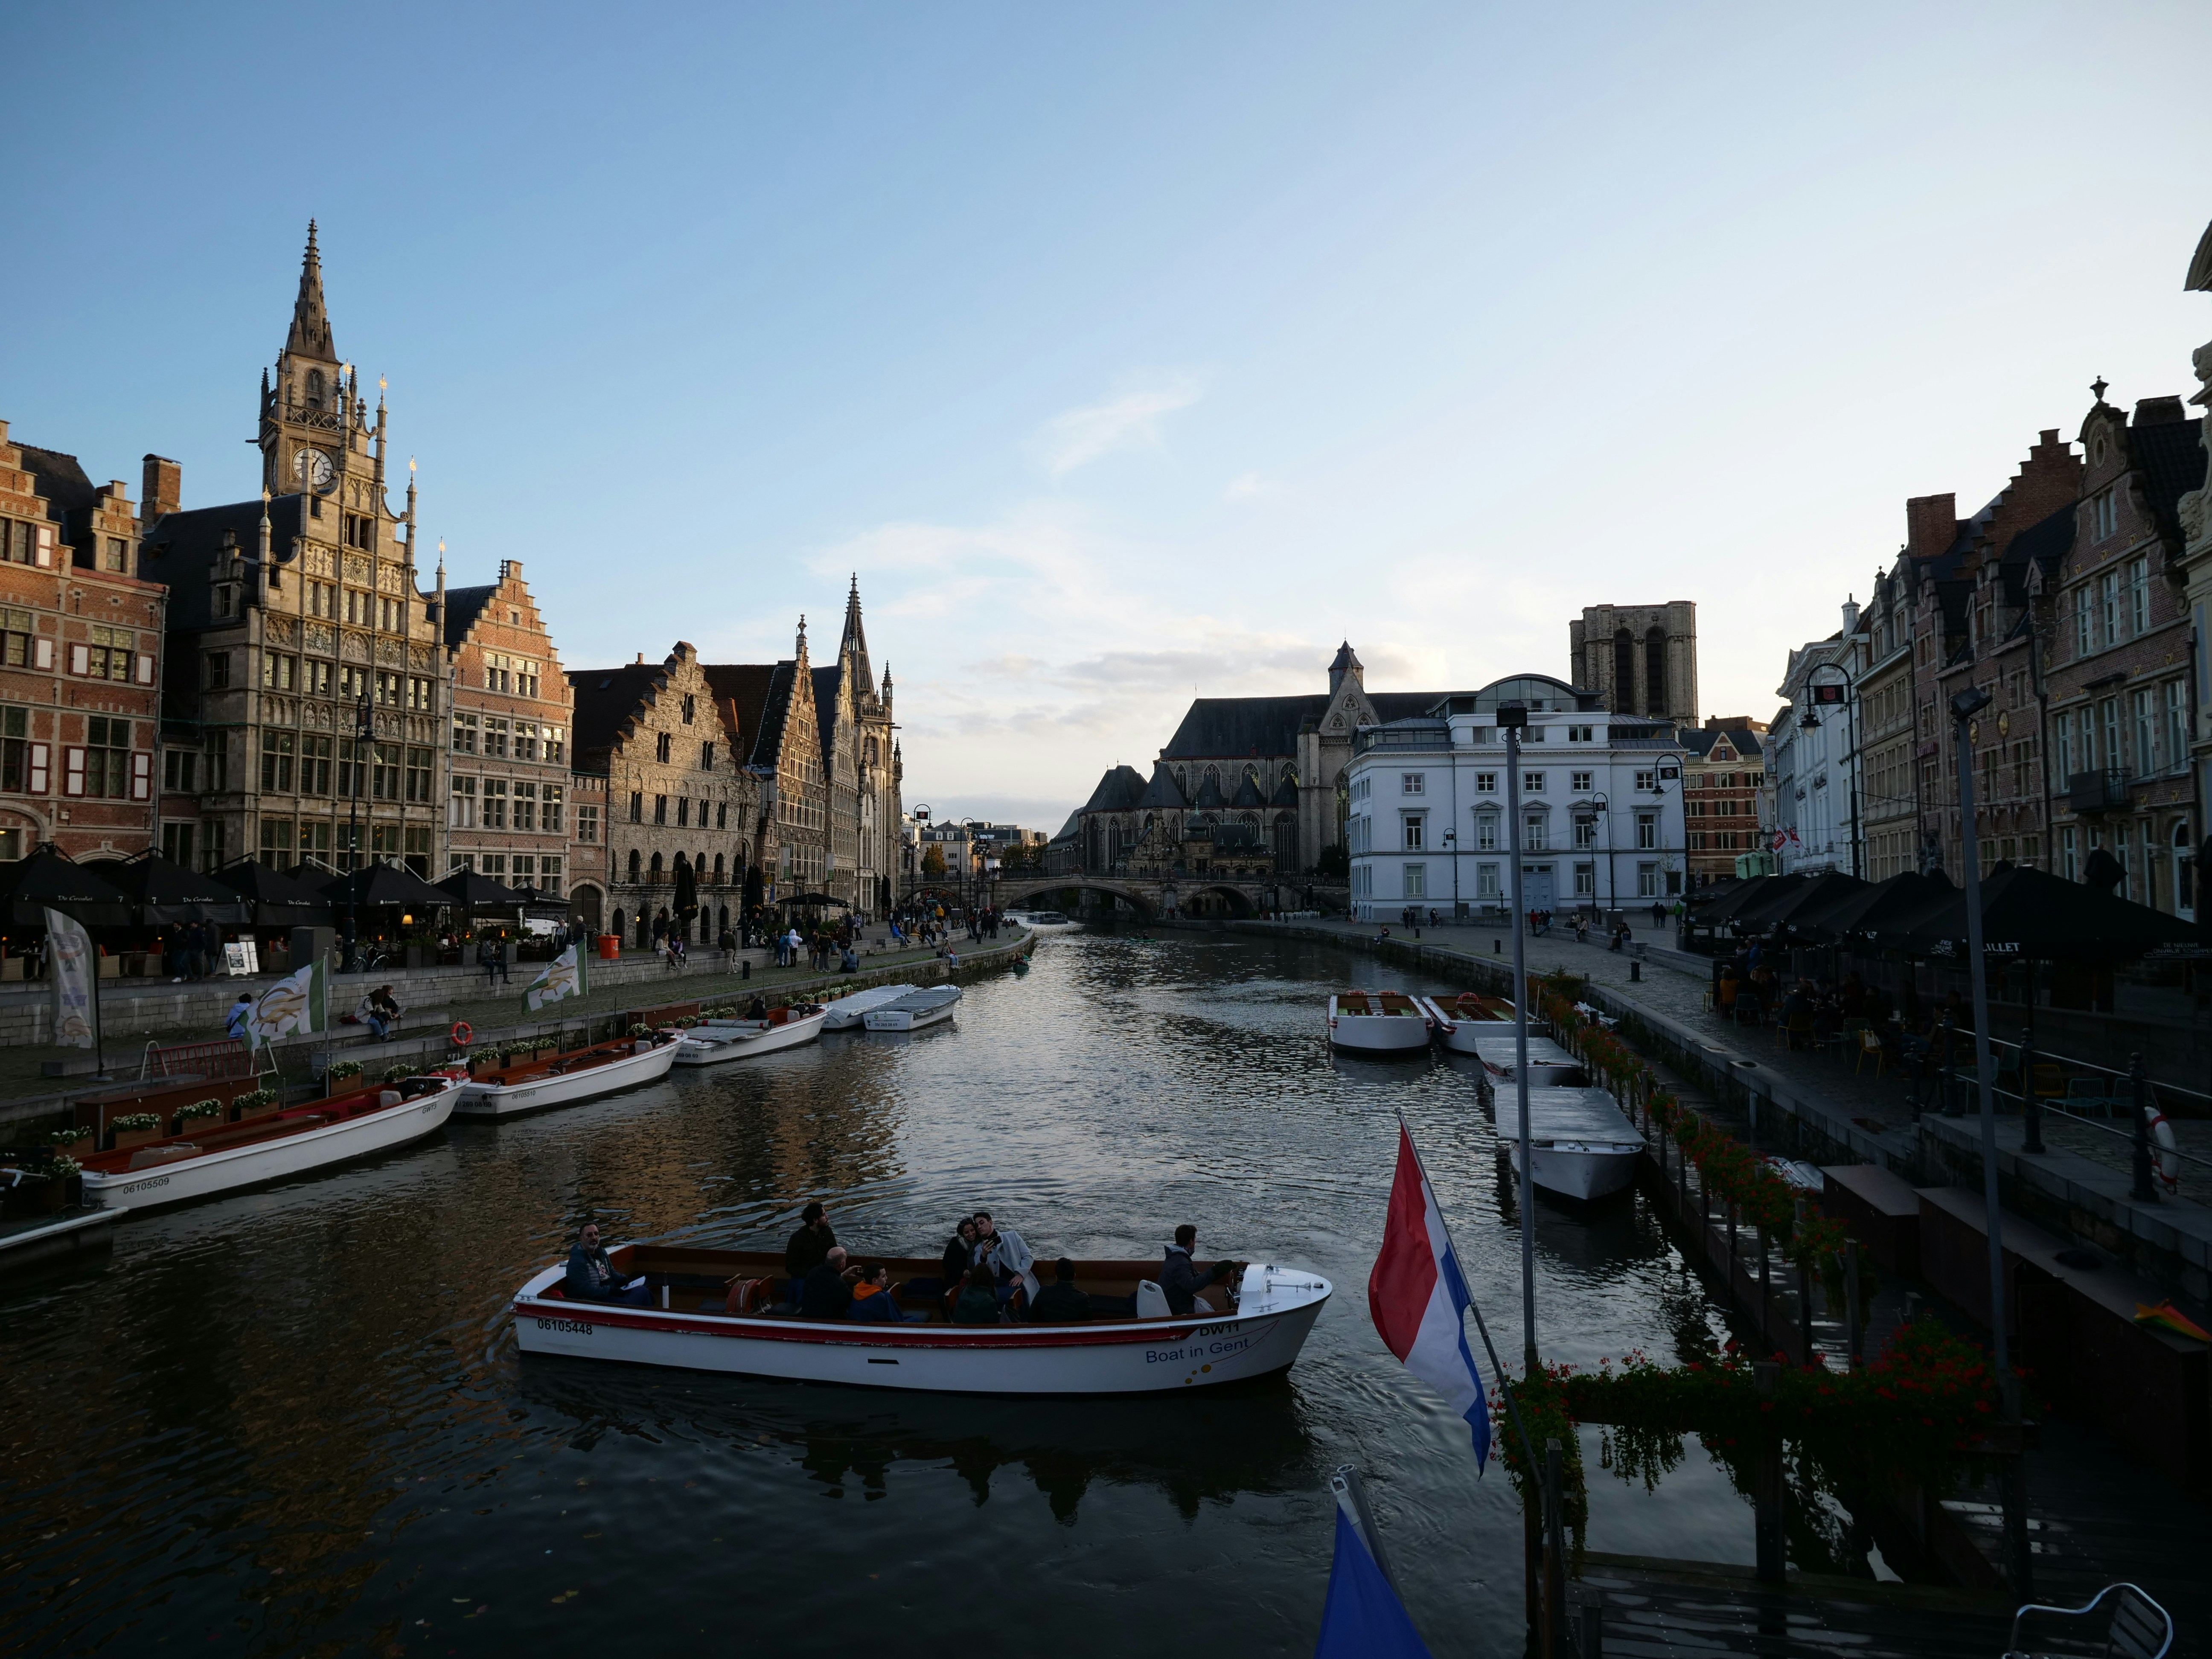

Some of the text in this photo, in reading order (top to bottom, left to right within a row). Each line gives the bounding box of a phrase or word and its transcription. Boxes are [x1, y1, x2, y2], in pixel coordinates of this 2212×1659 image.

[646, 870, 729, 885] MANHAT BURGERS
[512, 1090, 536, 1100] 06105510
[123, 1177, 169, 1194] 06105509
[538, 1318, 593, 1335] 06105448
[1199, 1323, 1239, 1336] DW11
[1146, 1338, 1249, 1363] Boat in Gent
